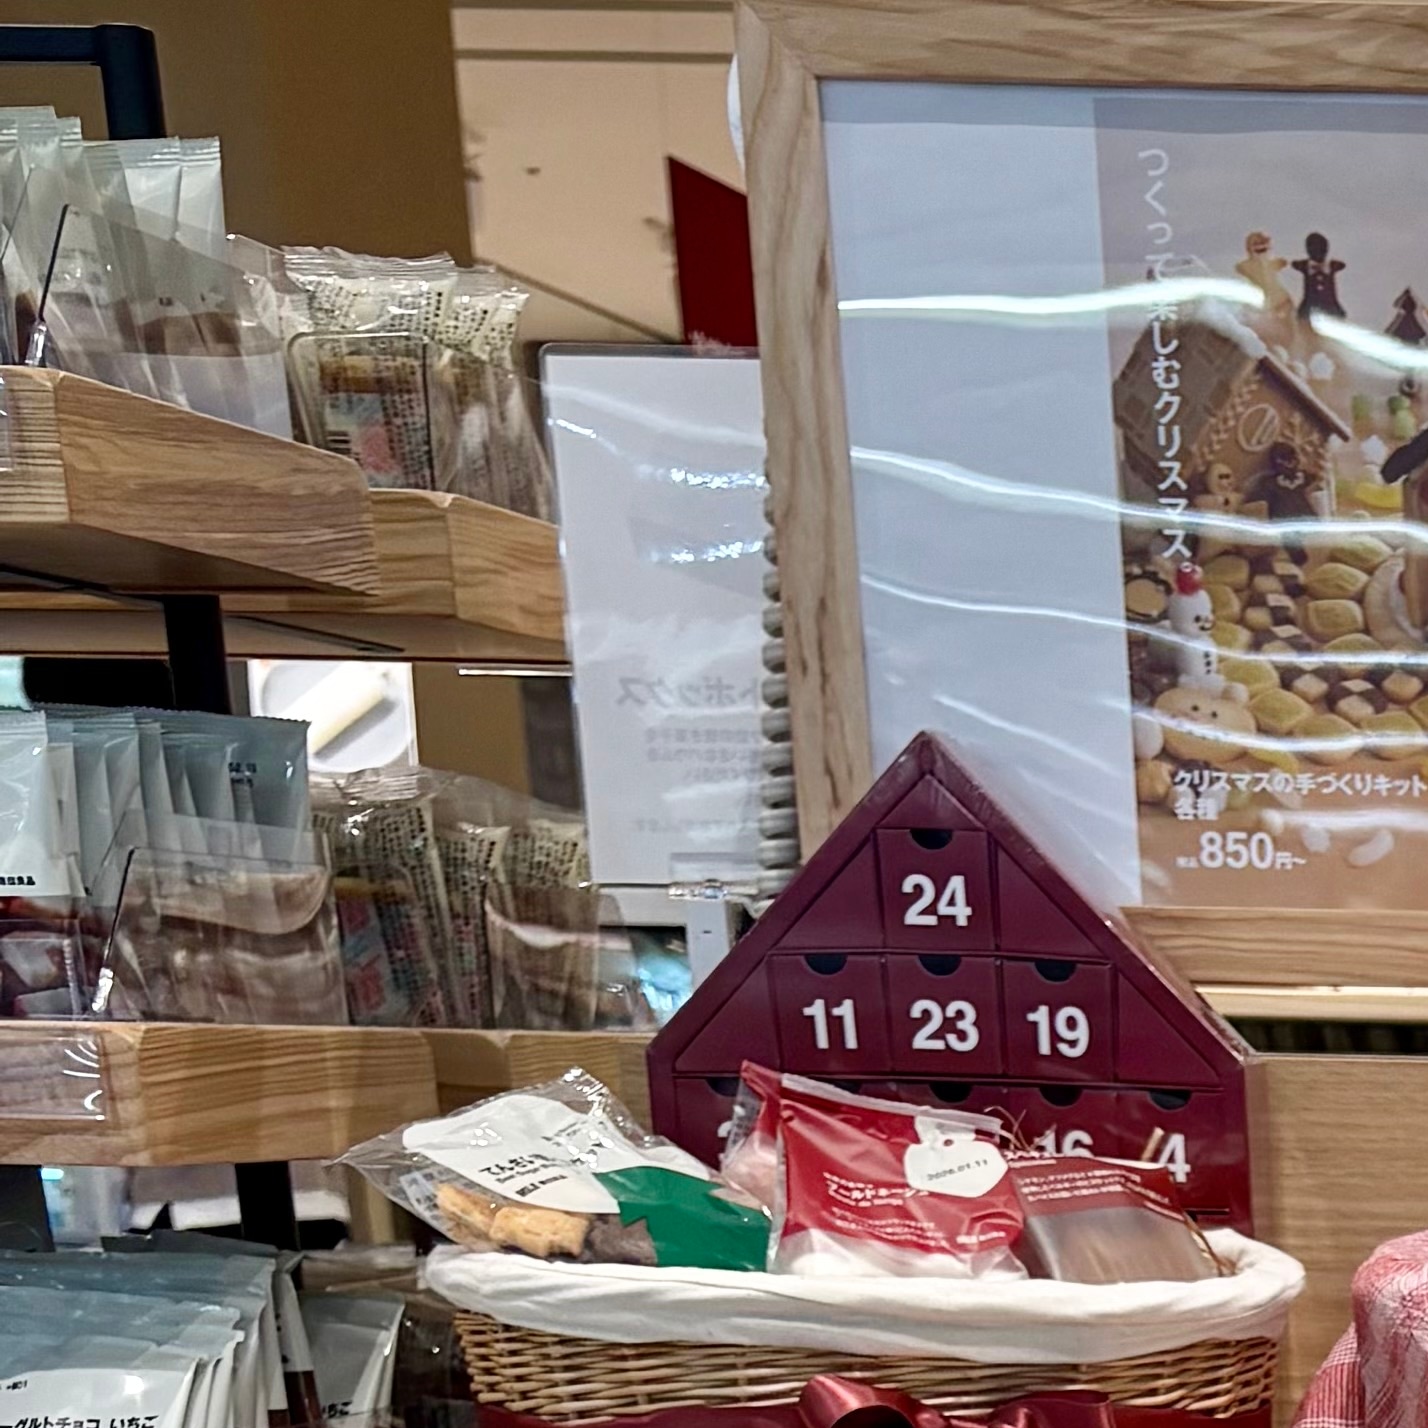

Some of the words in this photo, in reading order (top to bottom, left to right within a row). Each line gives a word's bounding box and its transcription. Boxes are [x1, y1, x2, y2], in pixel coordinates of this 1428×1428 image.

[1174, 769, 1427, 799] クリスマスの手づくりキット
[902, 875, 971, 928] 24
[803, 999, 859, 1051] 11
[910, 1000, 978, 1052] 23
[1027, 1005, 1090, 1057] 19
